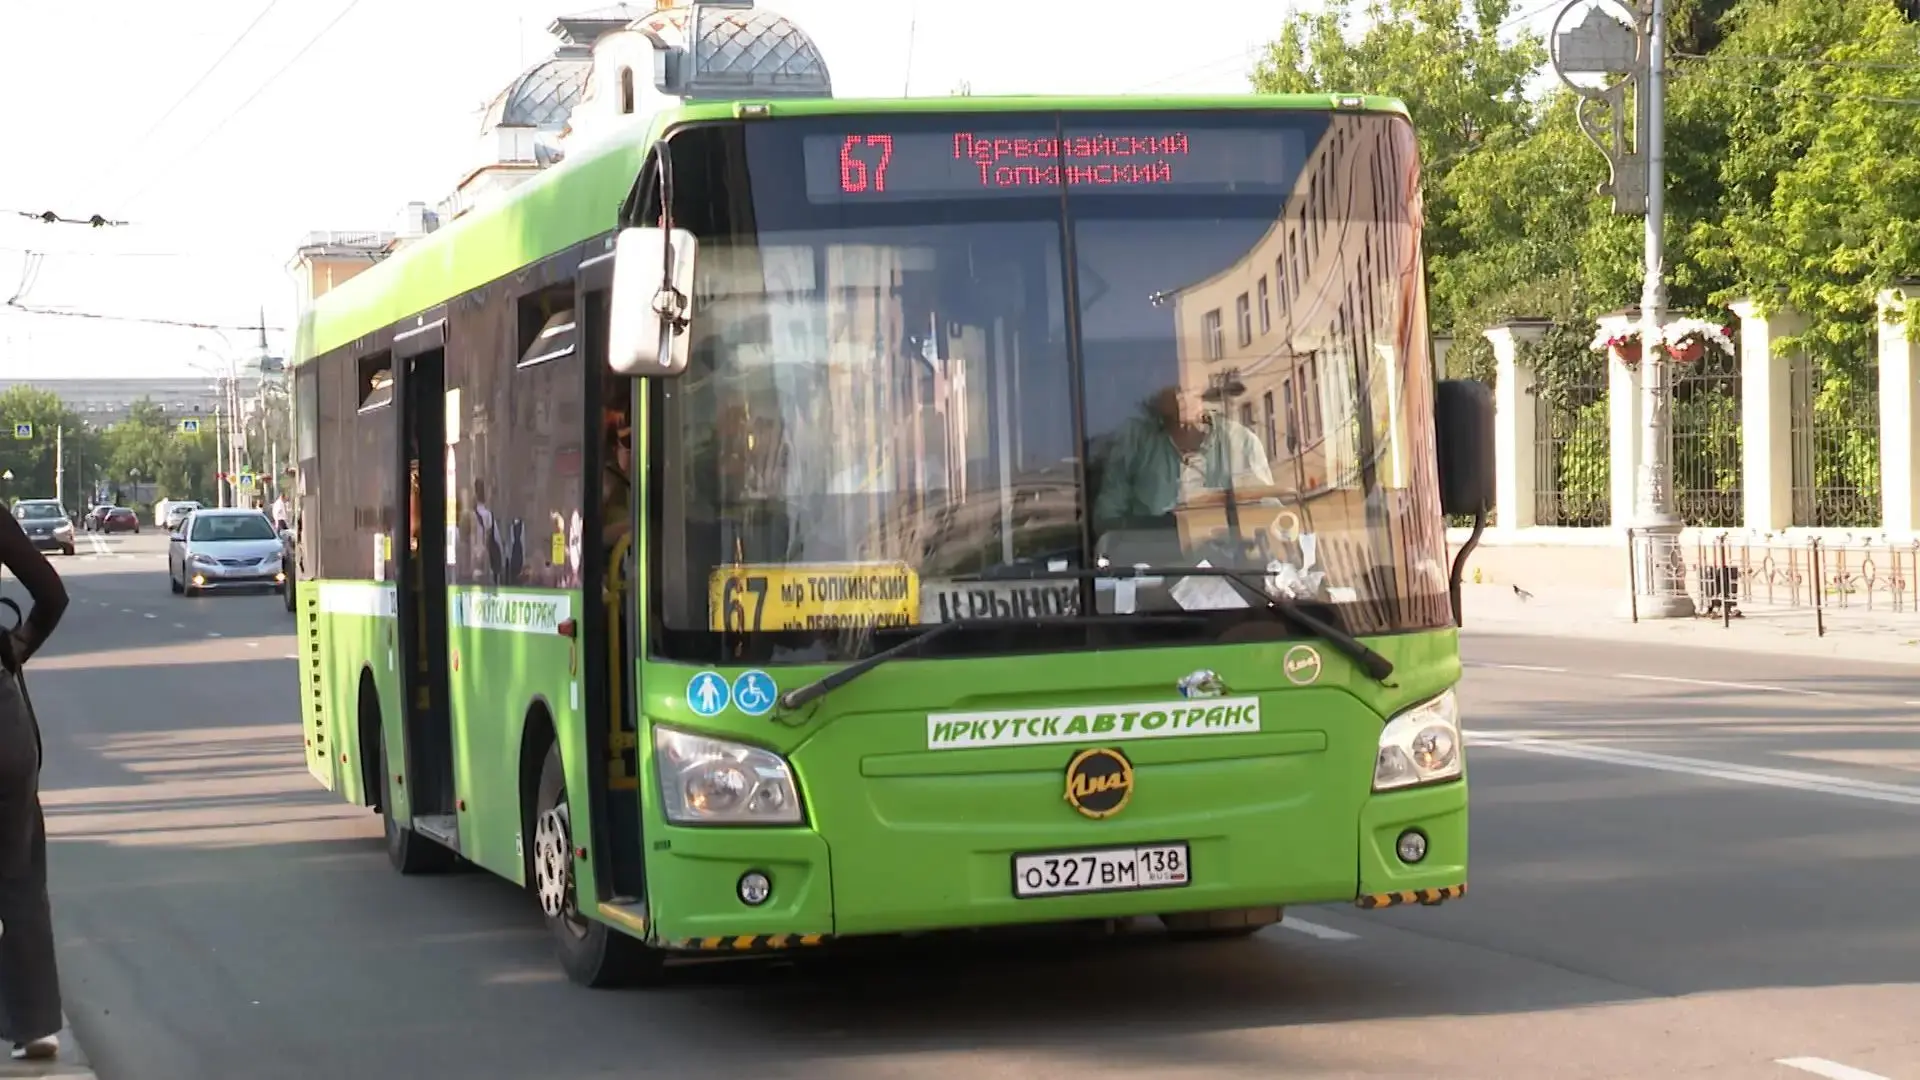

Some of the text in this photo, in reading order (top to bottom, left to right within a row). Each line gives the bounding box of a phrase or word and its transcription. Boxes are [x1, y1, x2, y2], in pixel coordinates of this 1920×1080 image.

[952, 131, 1190, 158] Первомайский
[840, 133, 893, 192] 67
[977, 160, 1173, 187] Топкинский
[807, 575, 909, 601] ТОПКИНСКИЙ
[723, 576, 768, 633] 67
[932, 704, 1256, 742] ИРКУТСКАВТОТРАНС
[1140, 849, 1180, 873] 138
